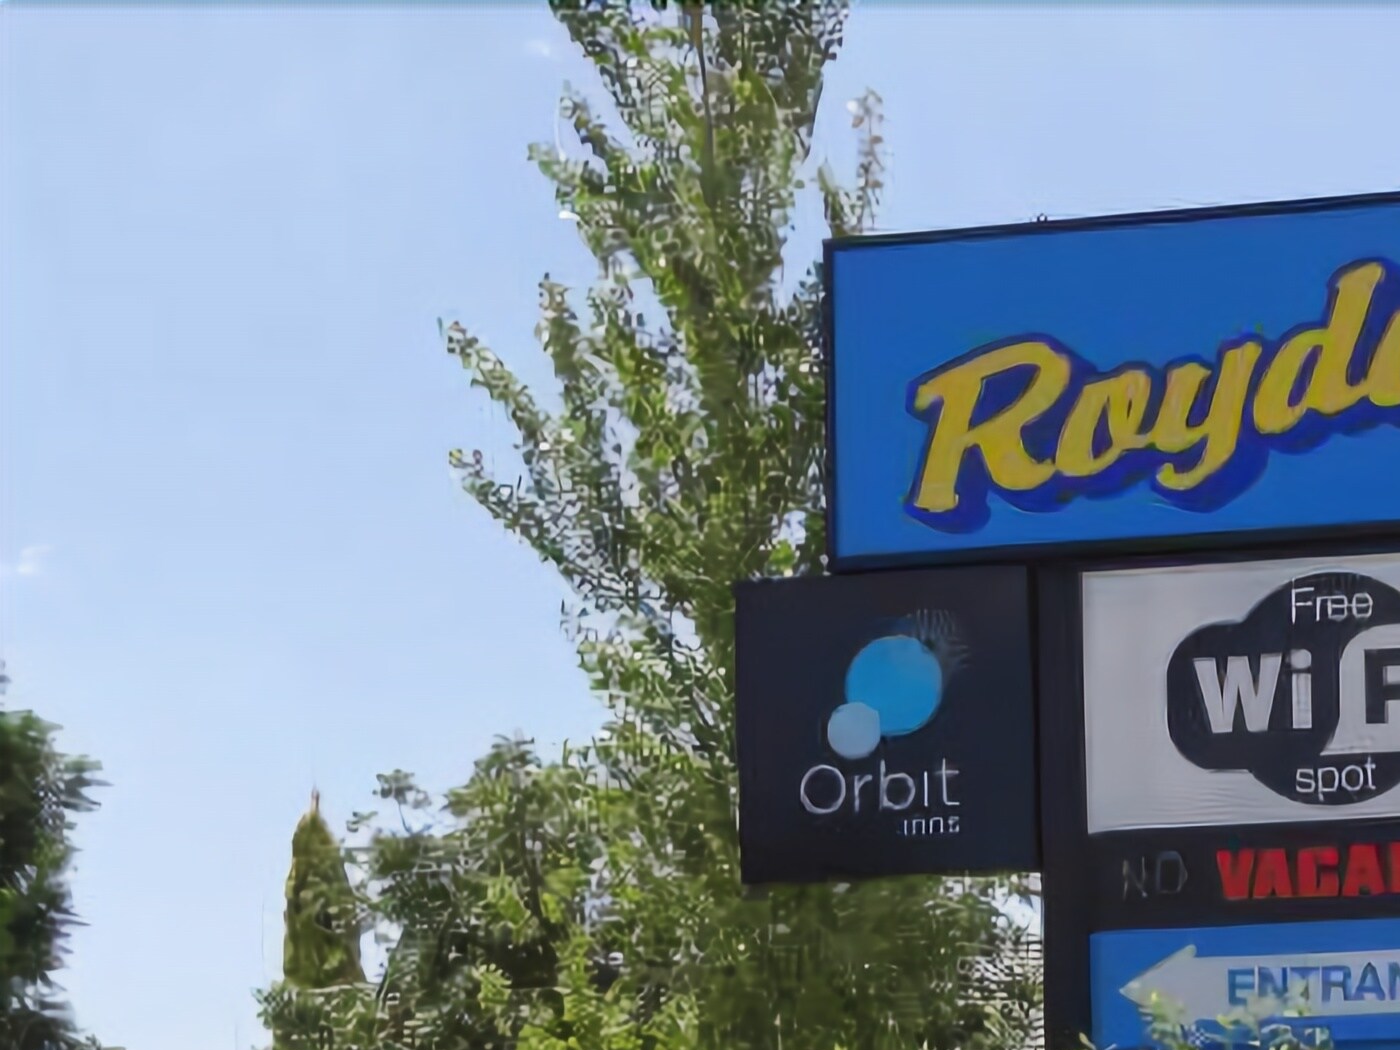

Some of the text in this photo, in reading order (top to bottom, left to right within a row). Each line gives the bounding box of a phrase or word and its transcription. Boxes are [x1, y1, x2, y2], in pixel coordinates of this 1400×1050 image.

[1291, 586, 1373, 624] Free
[800, 758, 961, 814] Orbit
[1295, 756, 1376, 801] spot
